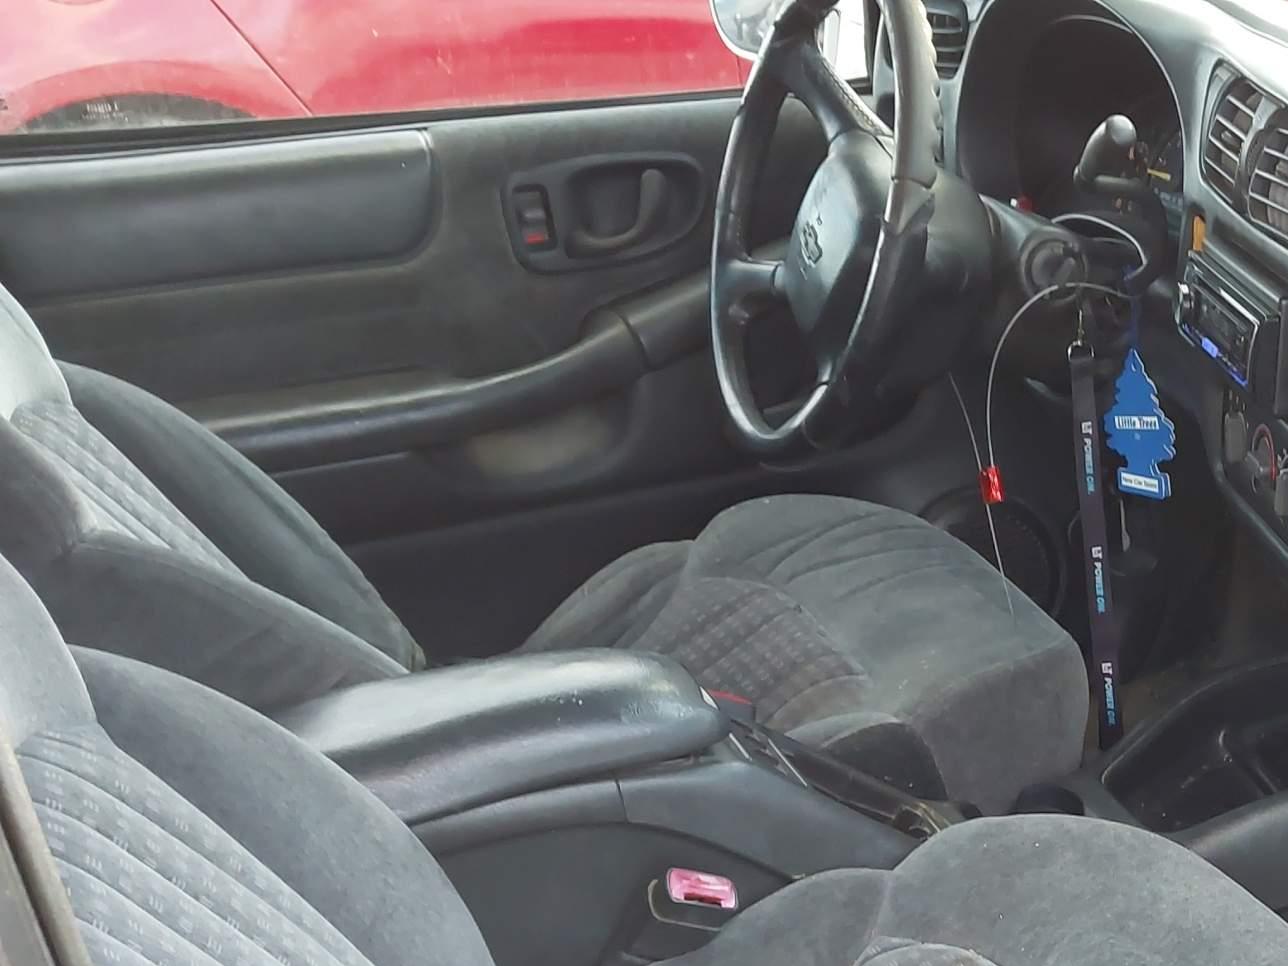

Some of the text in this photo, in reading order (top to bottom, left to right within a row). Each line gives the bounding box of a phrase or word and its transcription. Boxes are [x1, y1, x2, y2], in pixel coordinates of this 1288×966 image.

[1118, 416, 1157, 428] Little Trees
[1084, 438, 1094, 474] POWER
[1094, 562, 1104, 596] POWER
[1104, 677, 1115, 709] POWER
